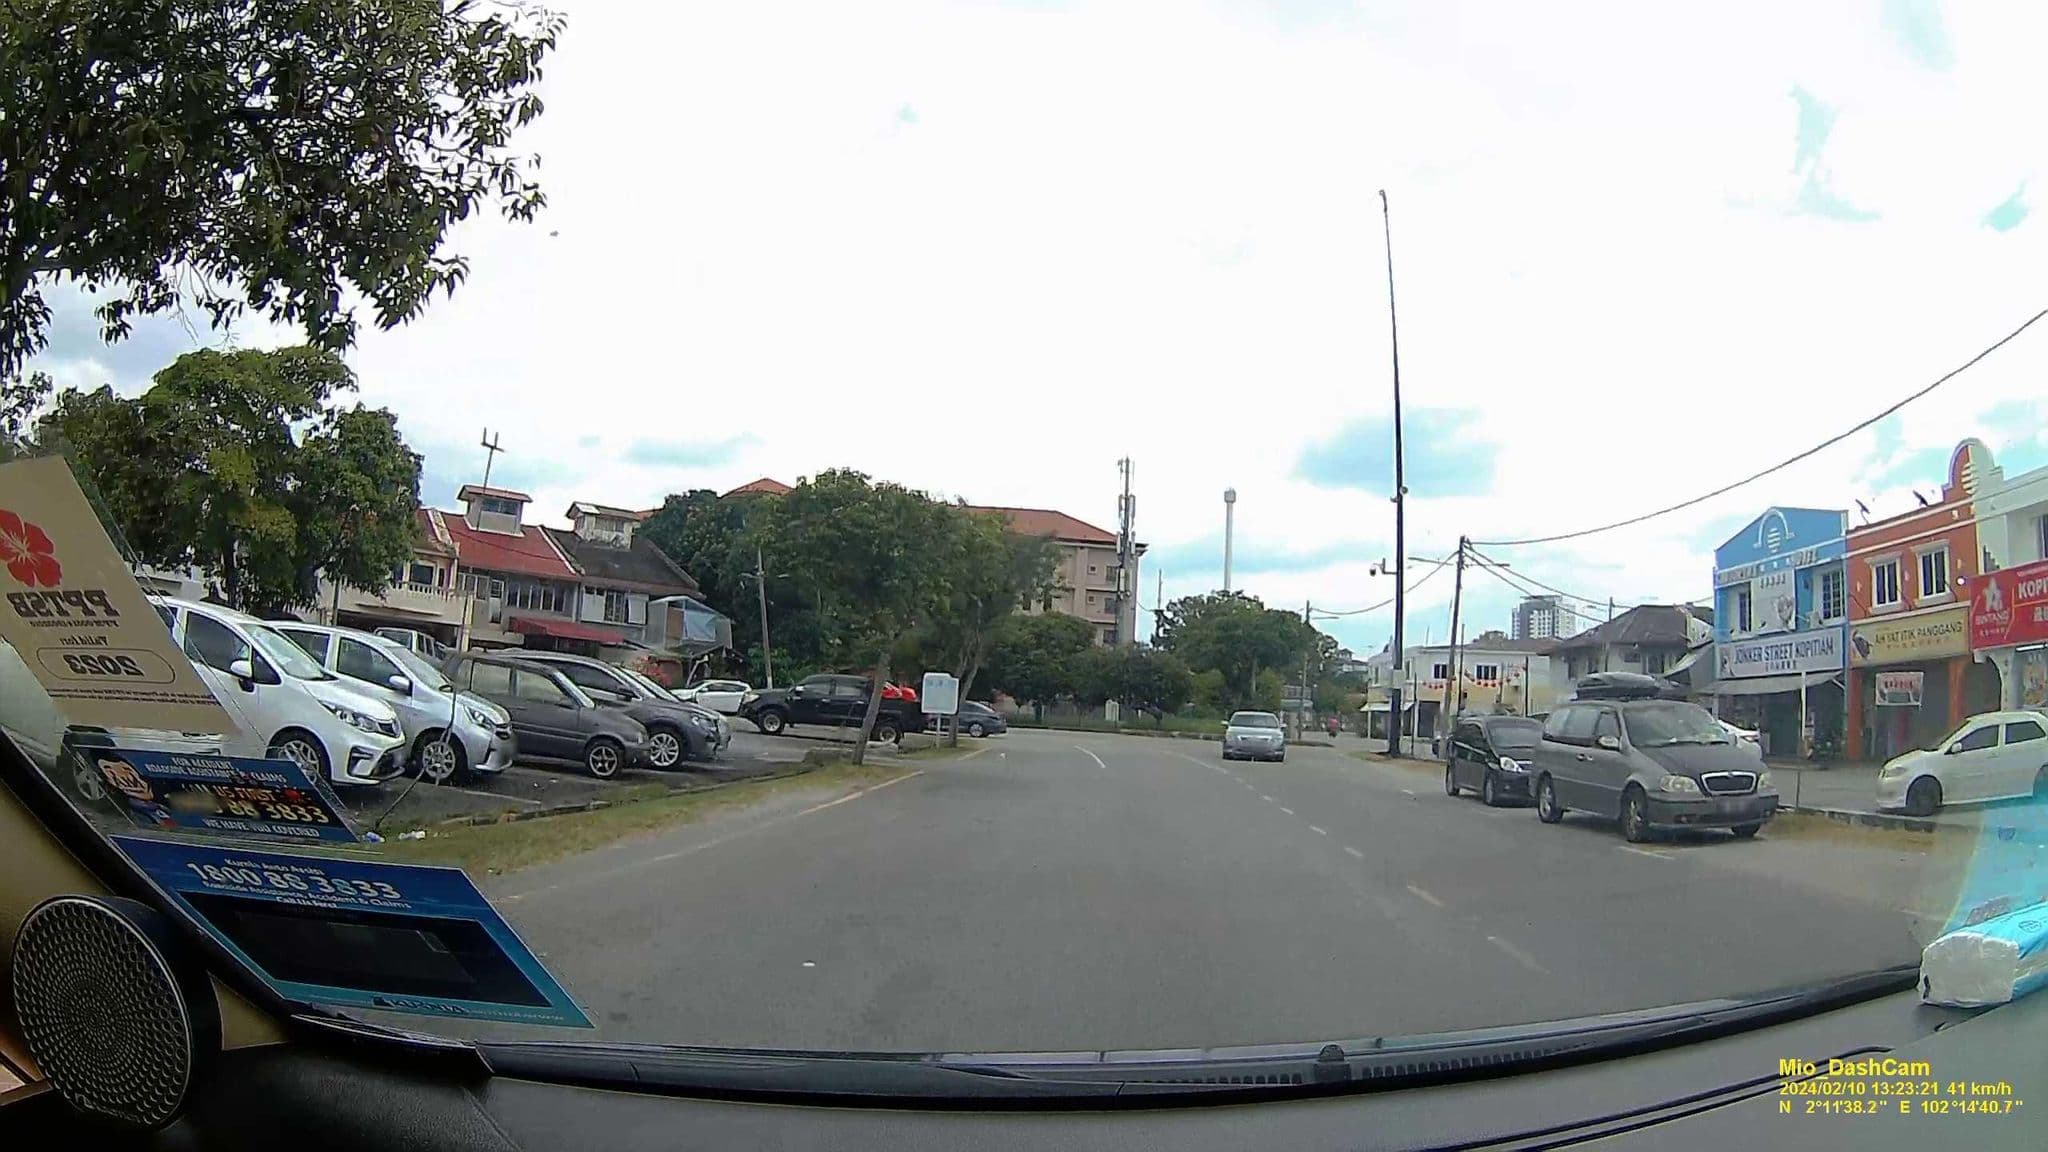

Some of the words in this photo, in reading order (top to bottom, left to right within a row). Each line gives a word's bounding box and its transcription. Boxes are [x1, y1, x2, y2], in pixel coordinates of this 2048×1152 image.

[1917, 621, 1962, 637] PANGGANG
[1734, 646, 1763, 664] JONKER
[1764, 642, 1793, 661] STREET
[1795, 636, 1835, 659] KOPITIAM
[192, 760, 233, 771] ACCIDENT
[145, 764, 187, 775] ROADSIDE
[187, 767, 239, 779] ASSISTANCE
[250, 772, 287, 784] CLAIMS
[214, 785, 235, 799] US
[237, 787, 277, 801] FIRST
[227, 800, 259, 817] 88
[261, 803, 330, 824] 3833
[223, 821, 248, 832] HAVE
[271, 824, 320, 838] COVERED
[187, 862, 262, 887] 1800
[263, 871, 309, 891] 88
[309, 876, 402, 899] 3833
[368, 898, 412, 910] Claims
[388, 999, 466, 1015] KURNIA
